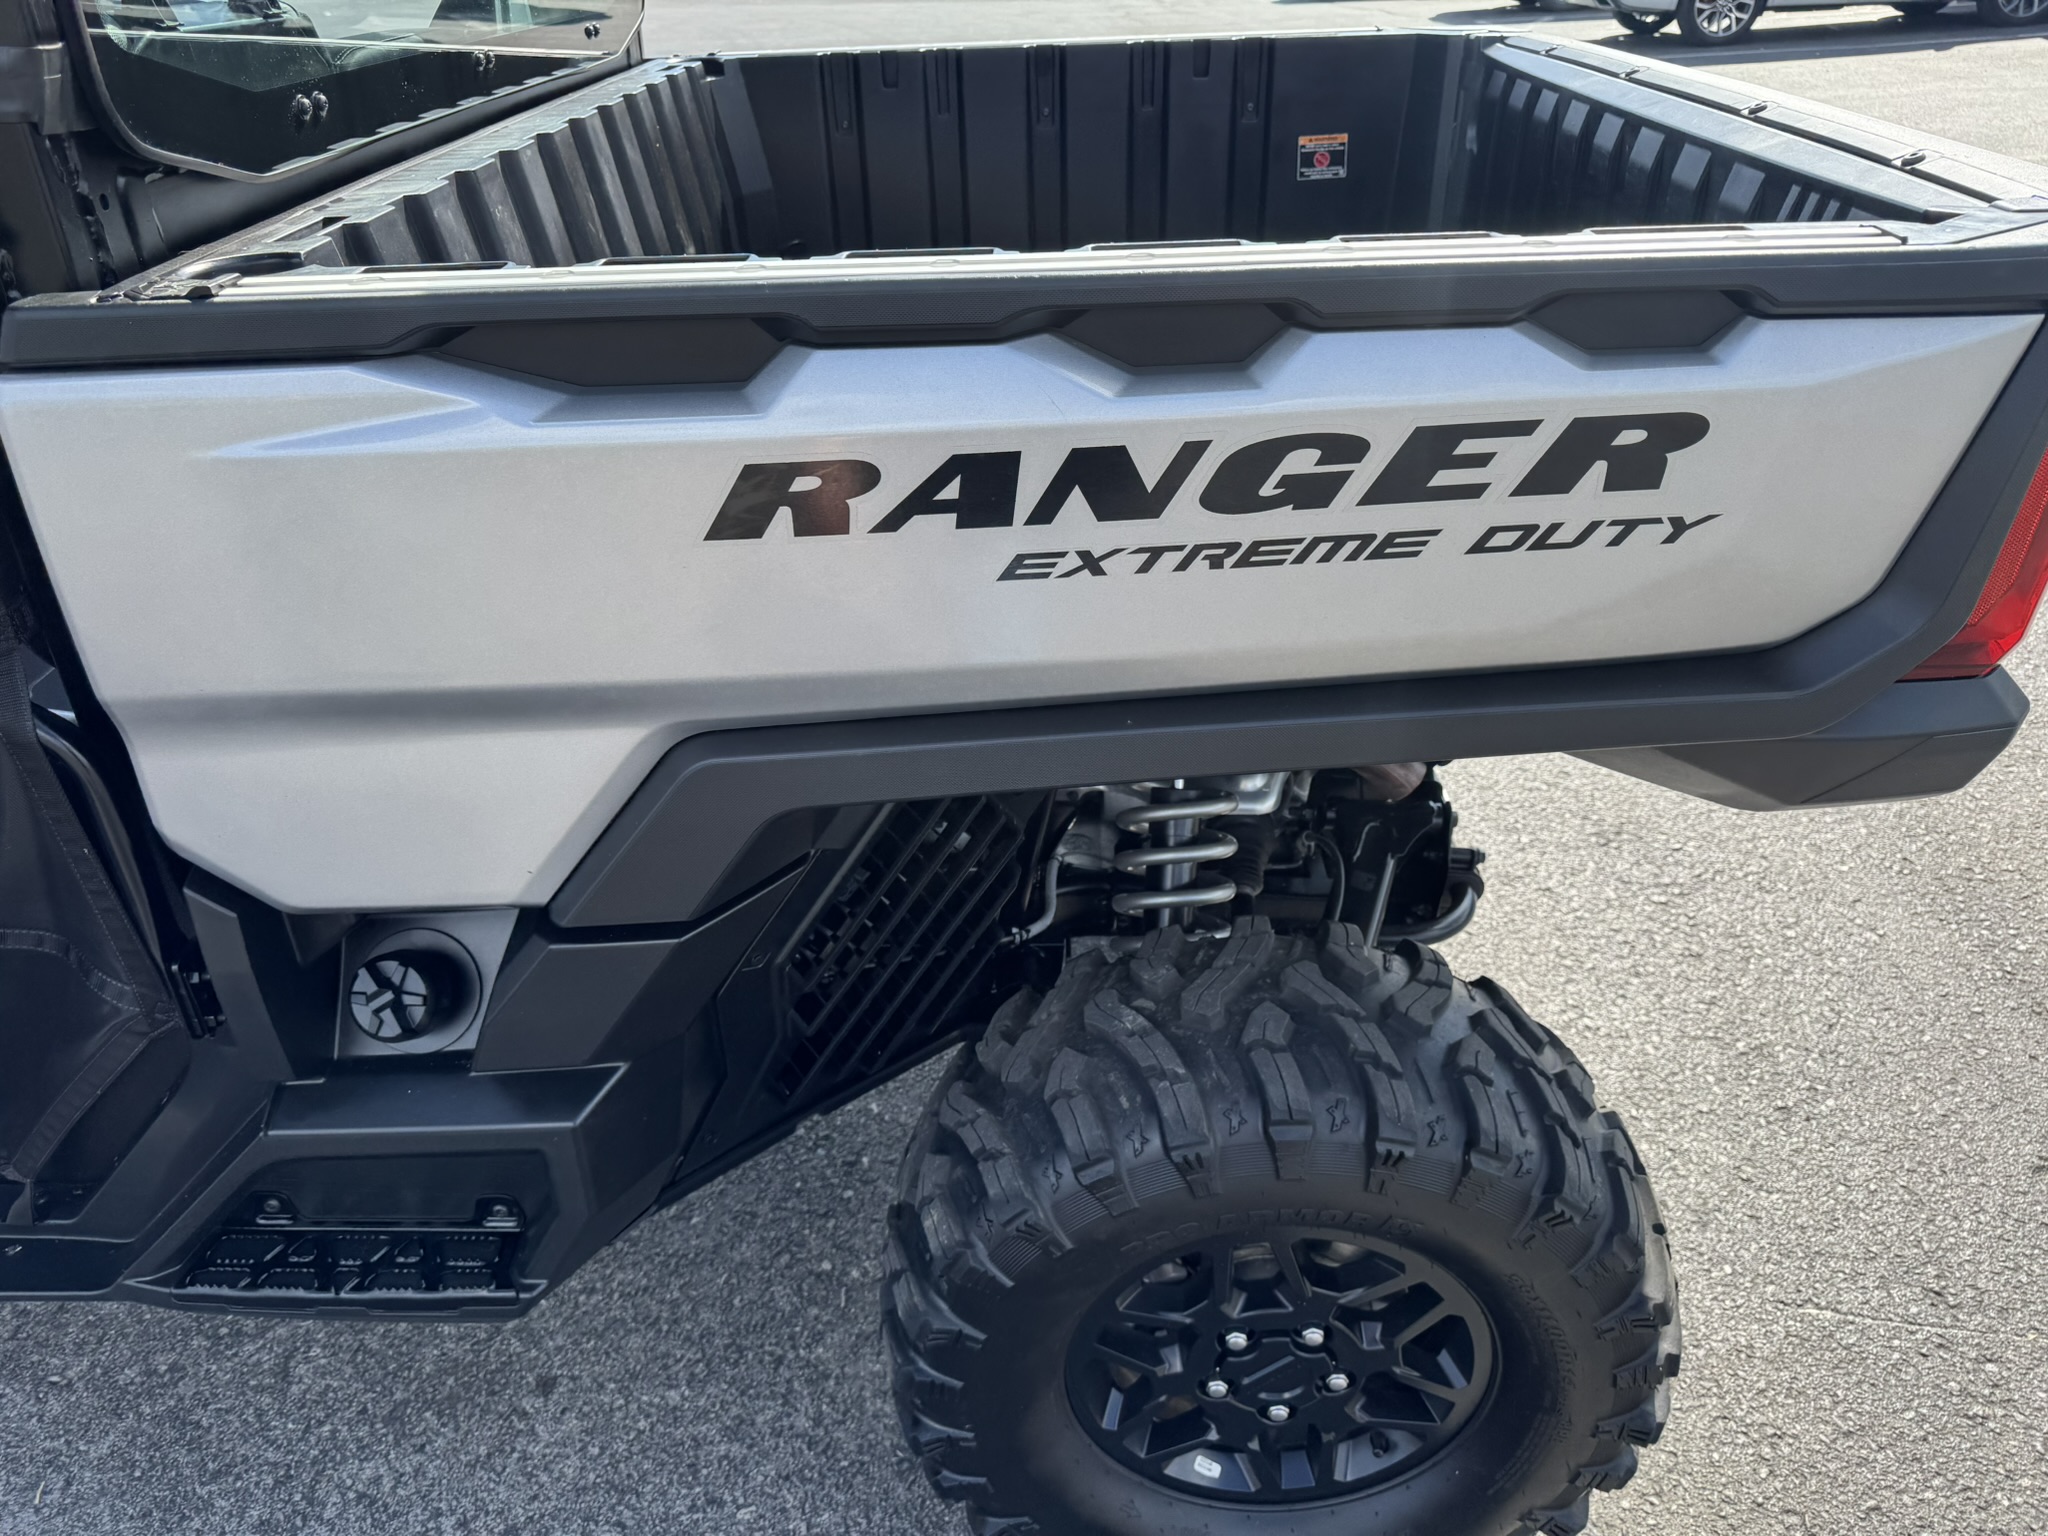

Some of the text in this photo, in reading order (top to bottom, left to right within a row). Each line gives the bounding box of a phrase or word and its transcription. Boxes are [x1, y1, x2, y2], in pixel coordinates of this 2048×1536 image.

[704, 412, 1710, 541] RANGER
[997, 514, 1722, 581] EXTREME DUTY
